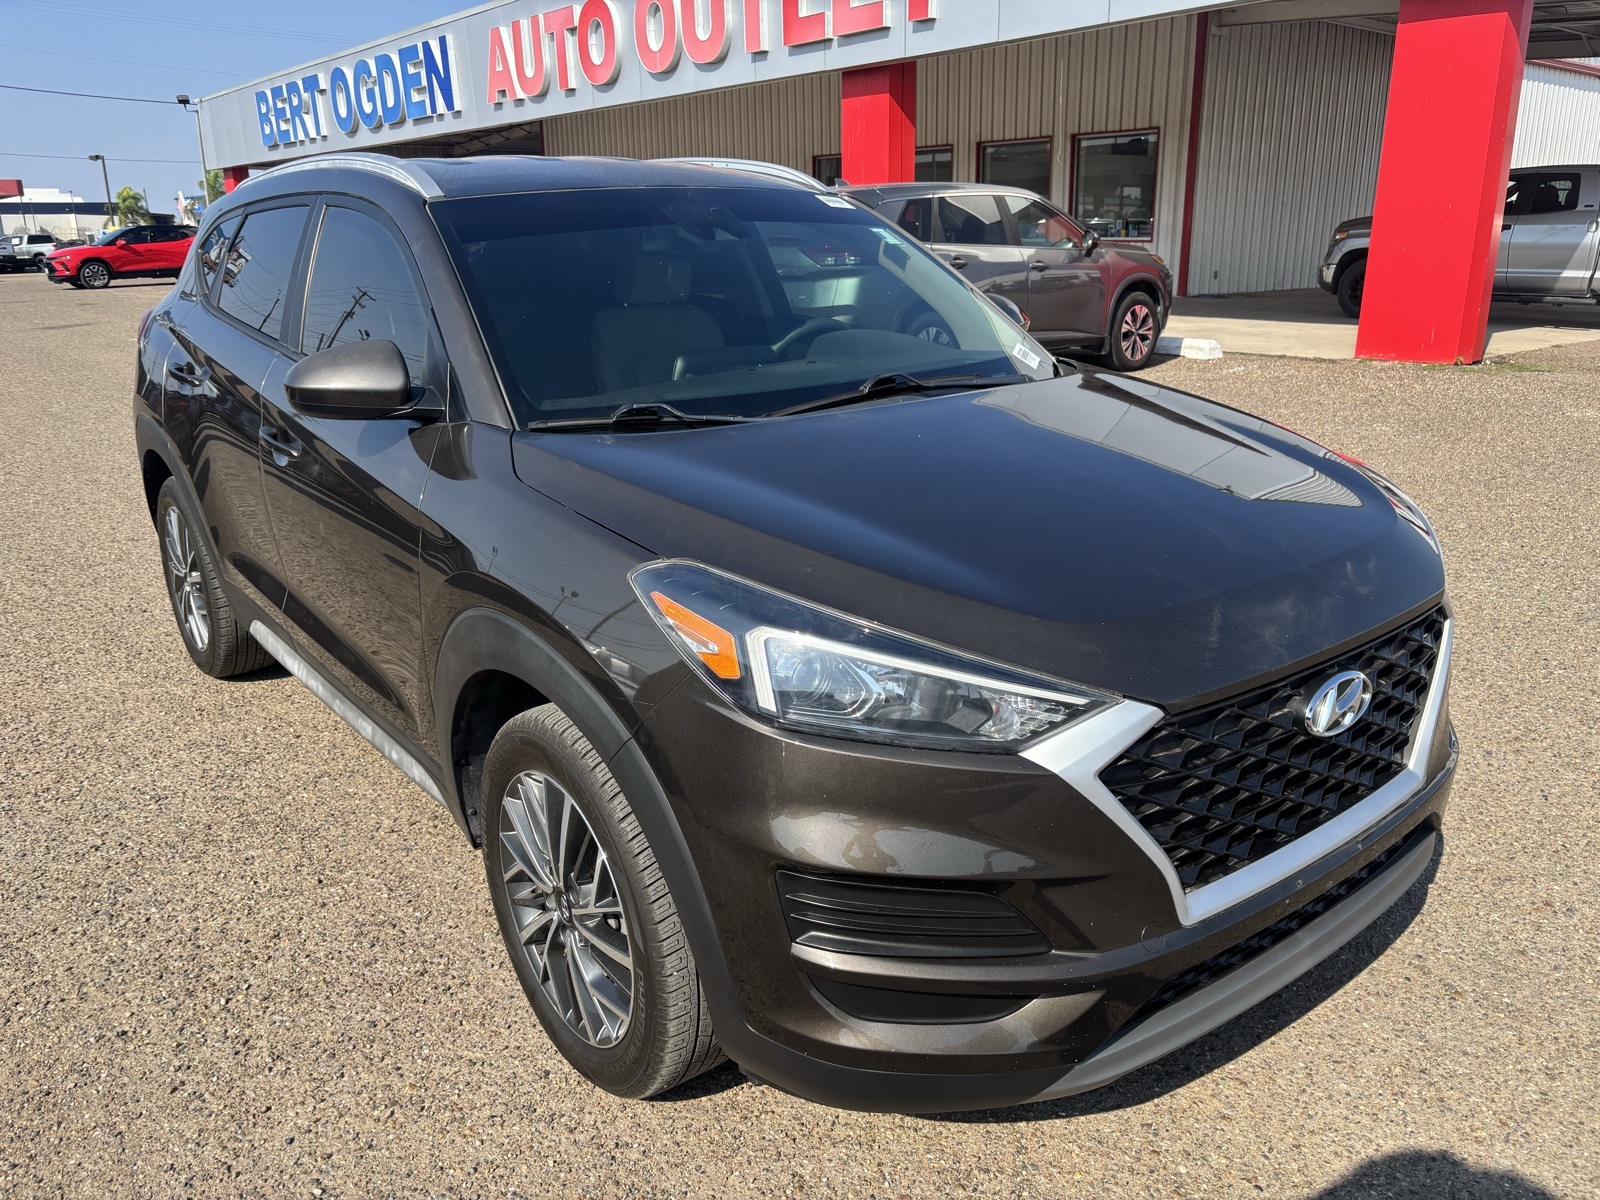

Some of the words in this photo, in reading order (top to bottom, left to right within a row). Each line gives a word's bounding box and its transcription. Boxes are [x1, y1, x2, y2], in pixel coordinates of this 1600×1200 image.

[254, 73, 326, 147] BERT
[330, 34, 460, 134] OGDEN
[487, 0, 619, 104] AUTO
[633, 0, 936, 74] OUTL
